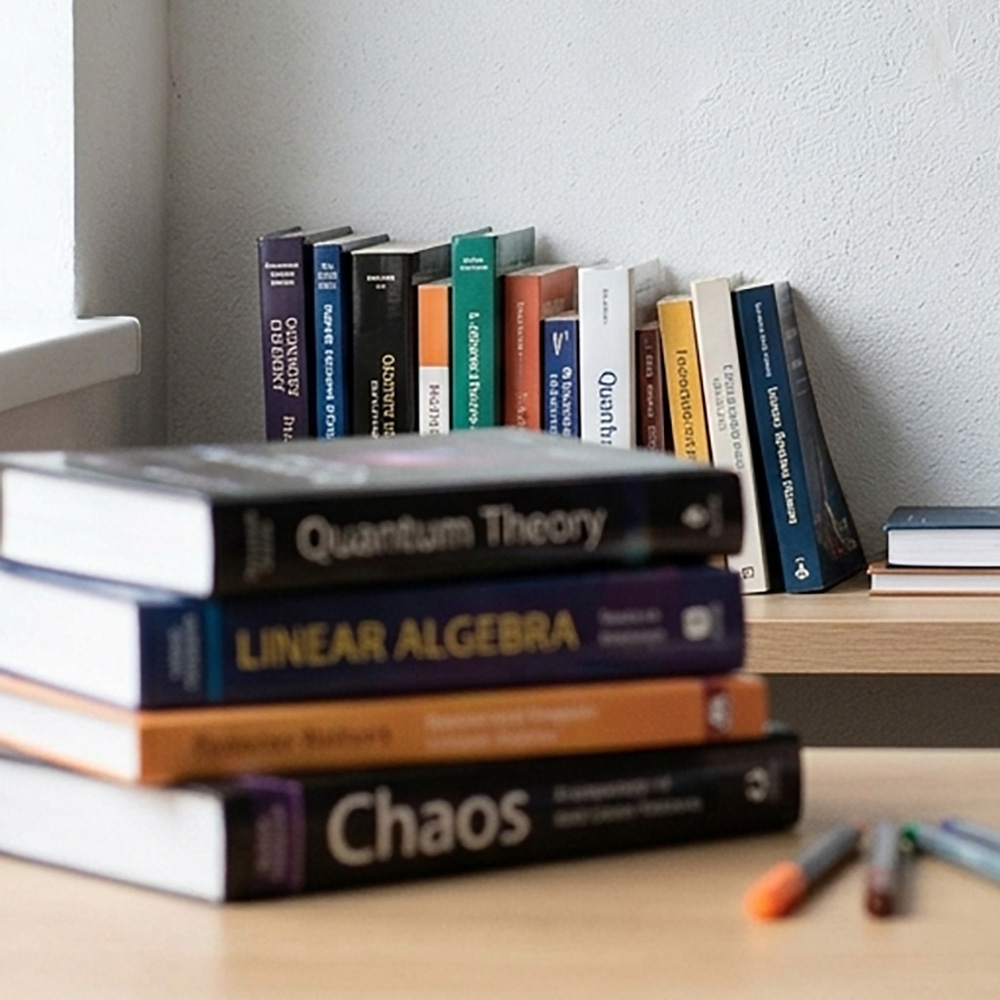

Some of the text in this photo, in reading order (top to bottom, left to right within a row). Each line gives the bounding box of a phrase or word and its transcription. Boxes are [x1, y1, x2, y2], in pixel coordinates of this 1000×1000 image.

[295, 513, 475, 565] Quantum
[478, 502, 608, 551] Theory
[236, 620, 388, 673] LINEAR
[393, 610, 581, 662] ALGEBRA
[326, 784, 531, 867] Chaos
